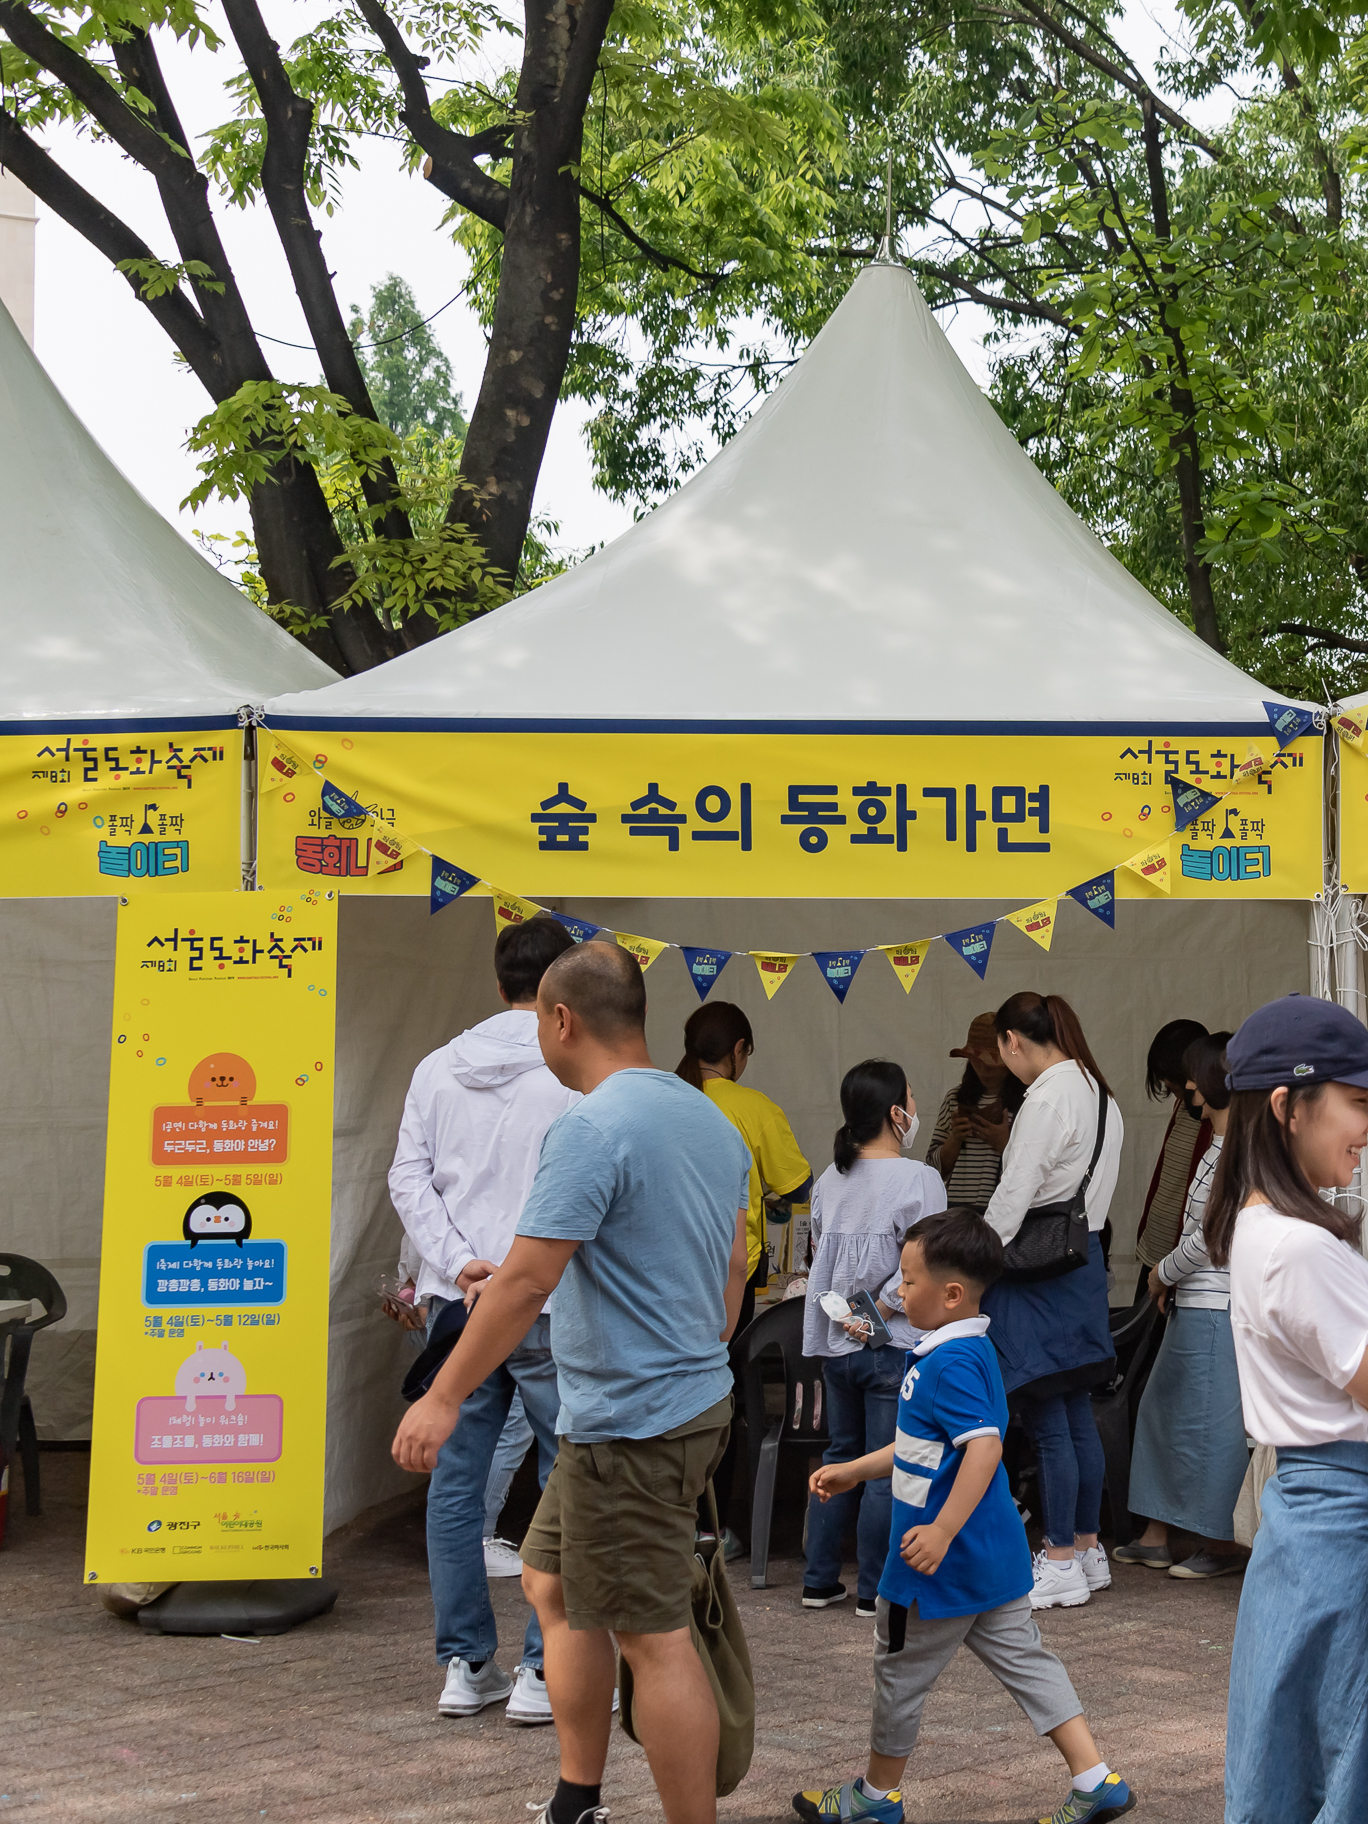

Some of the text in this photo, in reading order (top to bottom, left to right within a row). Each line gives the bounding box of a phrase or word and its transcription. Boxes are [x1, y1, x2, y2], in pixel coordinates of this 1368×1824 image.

[37, 738, 224, 789] 서울동화축제
[32, 769, 70, 783] 제8회
[1114, 771, 1151, 785] 제8회
[108, 813, 184, 836] 폴짝 폴짝
[530, 781, 1051, 853] 숲 속의 동화가면
[1190, 818, 1265, 840] 폴짝 폴짝
[98, 840, 189, 877] 놀이터
[295, 835, 403, 877] 동화나
[1180, 844, 1271, 881] 놀이터
[146, 928, 322, 978] 서울동화축제
[140, 958, 177, 972] 제8회
[164, 1138, 276, 1154] 두근두근, 동화야 안녕?
[154, 1173, 283, 1187] 5월 4일(토)~5월 5일(일)
[208, 1278, 240, 1291] 동화야
[243, 1278, 273, 1290] 놀자~
[144, 1314, 281, 1327] 5월 4일(토)~5월 12일(일)
[202, 1434, 235, 1447] 동화와
[137, 1470, 276, 1485] 5월 4일(토)~6월 16일(일)
[166, 1521, 201, 1531] 광진구
